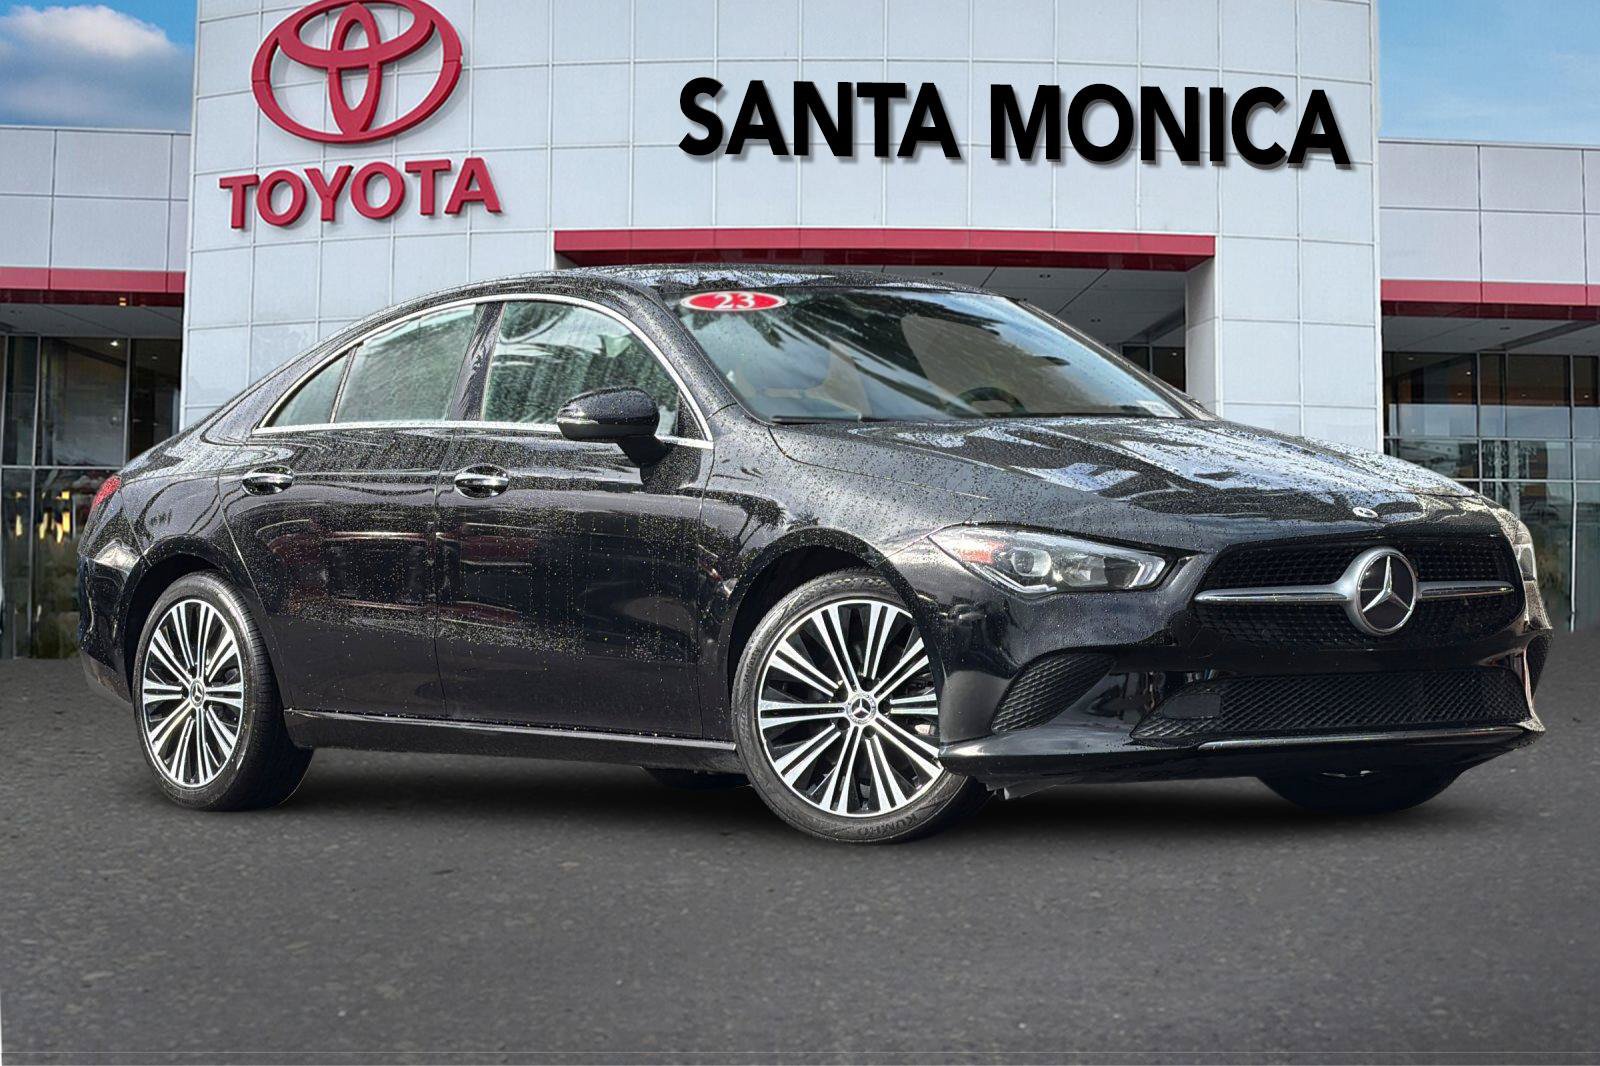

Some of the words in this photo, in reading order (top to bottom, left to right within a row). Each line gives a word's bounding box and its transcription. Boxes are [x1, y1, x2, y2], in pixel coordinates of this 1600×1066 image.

[678, 77, 962, 160] SANTA
[990, 83, 1352, 170] MONICA
[219, 157, 502, 229] TOYOTA
[714, 292, 756, 310] 23
